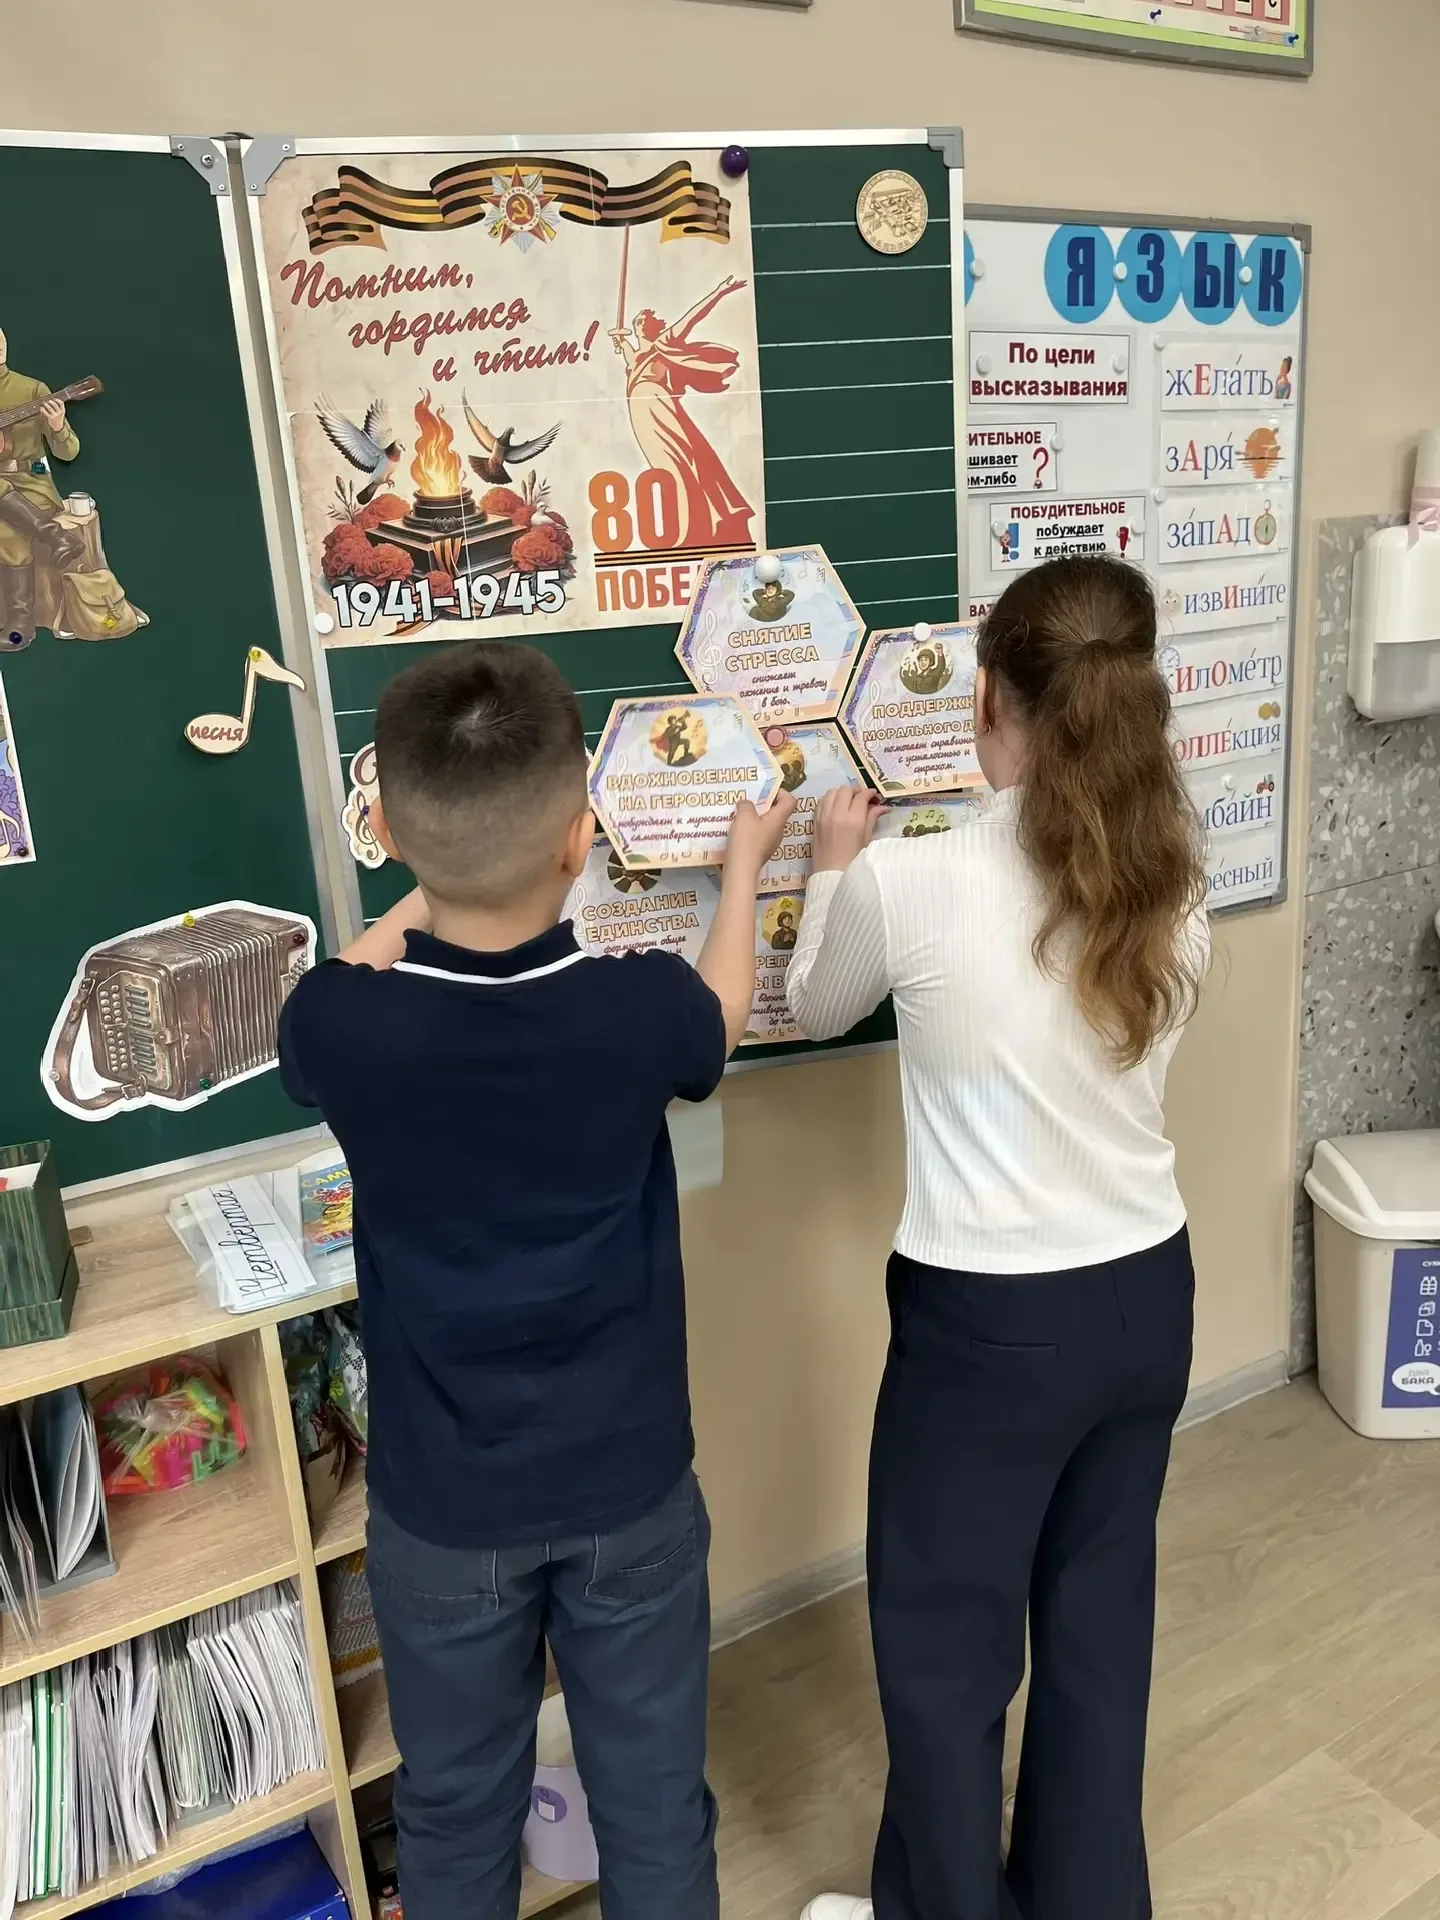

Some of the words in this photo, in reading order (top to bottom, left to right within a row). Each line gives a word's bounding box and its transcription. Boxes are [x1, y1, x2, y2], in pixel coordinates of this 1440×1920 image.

[280, 260, 474, 308] Помним,
[348, 297, 532, 356] гордимся
[433, 354, 457, 382] и
[474, 321, 600, 378] чтим!
[1008, 342, 1038, 364] По
[1045, 346, 1096, 367] цели
[971, 378, 1128, 397] высказывания
[966, 431, 1042, 446] ИТЕЛЬНОЕ
[967, 454, 1018, 466] шивает
[587, 468, 683, 553] 80
[1011, 502, 1126, 519] ПОБУДИТЕЛЬНОЕ
[1036, 523, 1104, 538] побуждает
[1034, 546, 1041, 556] к
[1045, 541, 1107, 557] действию
[596, 564, 702, 613] ПОБЕ
[331, 570, 566, 629] 1941-1945
[727, 622, 813, 649] СНЯТИЕ
[725, 645, 820, 672] СТРЕССА
[752, 671, 797, 685] снижает
[783, 685, 790, 693] и
[793, 677, 828, 694] тревогу
[872, 695, 975, 719] ПОДДЕРЖК
[189, 724, 245, 742] песня
[863, 720, 962, 742] МОРАЛЬНОГО
[963, 720, 975, 732] Д
[1172, 717, 1281, 762] ОЛЛЕ́кция
[884, 741, 927, 754] помогает
[905, 751, 961, 767] усталостью
[606, 766, 758, 791] ВДОХНОВЕНИЕ
[914, 763, 956, 775] страхом.
[619, 795, 647, 811] НА
[650, 790, 747, 810] ГЕРОИЗМ
[618, 816, 673, 831] побуждает
[676, 817, 683, 825] к
[687, 812, 736, 828] мужеств
[631, 829, 728, 843] самоотверженност
[582, 890, 698, 921] СОЗДАНИЕ
[586, 912, 700, 943] ЕДИНСТВА
[660, 934, 687, 947] общее
[755, 954, 792, 969] РЕП
[1401, 1377, 1435, 1385] БАКА
